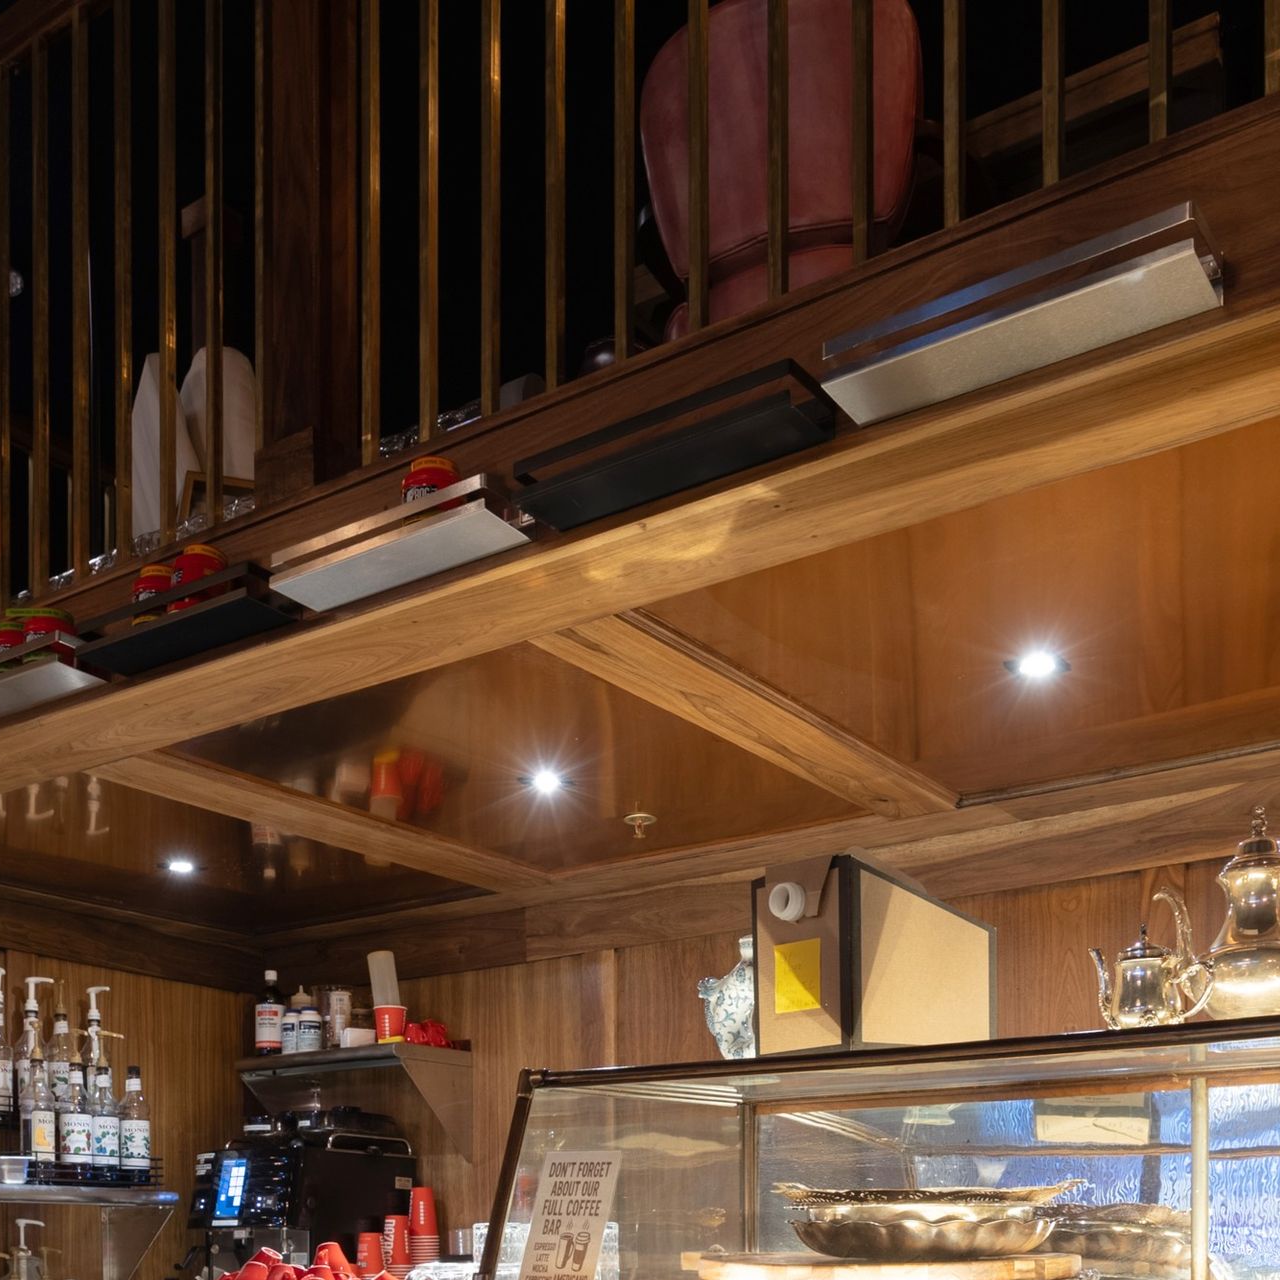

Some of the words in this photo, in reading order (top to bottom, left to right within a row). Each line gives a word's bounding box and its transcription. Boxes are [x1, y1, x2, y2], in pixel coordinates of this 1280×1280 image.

[549, 1162, 576, 1178] DON'T
[577, 1162, 612, 1178] FORGET
[551, 1181, 581, 1197] ABOUT
[581, 1181, 600, 1197] OUR
[542, 1200, 563, 1216] FULL
[566, 1200, 602, 1216] COFFEE
[542, 1219, 562, 1235] BAR
[534, 1242, 557, 1251] ESPRESSO
[535, 1253, 550, 1262] LATTE
[532, 1264, 548, 1273] MOCHA
